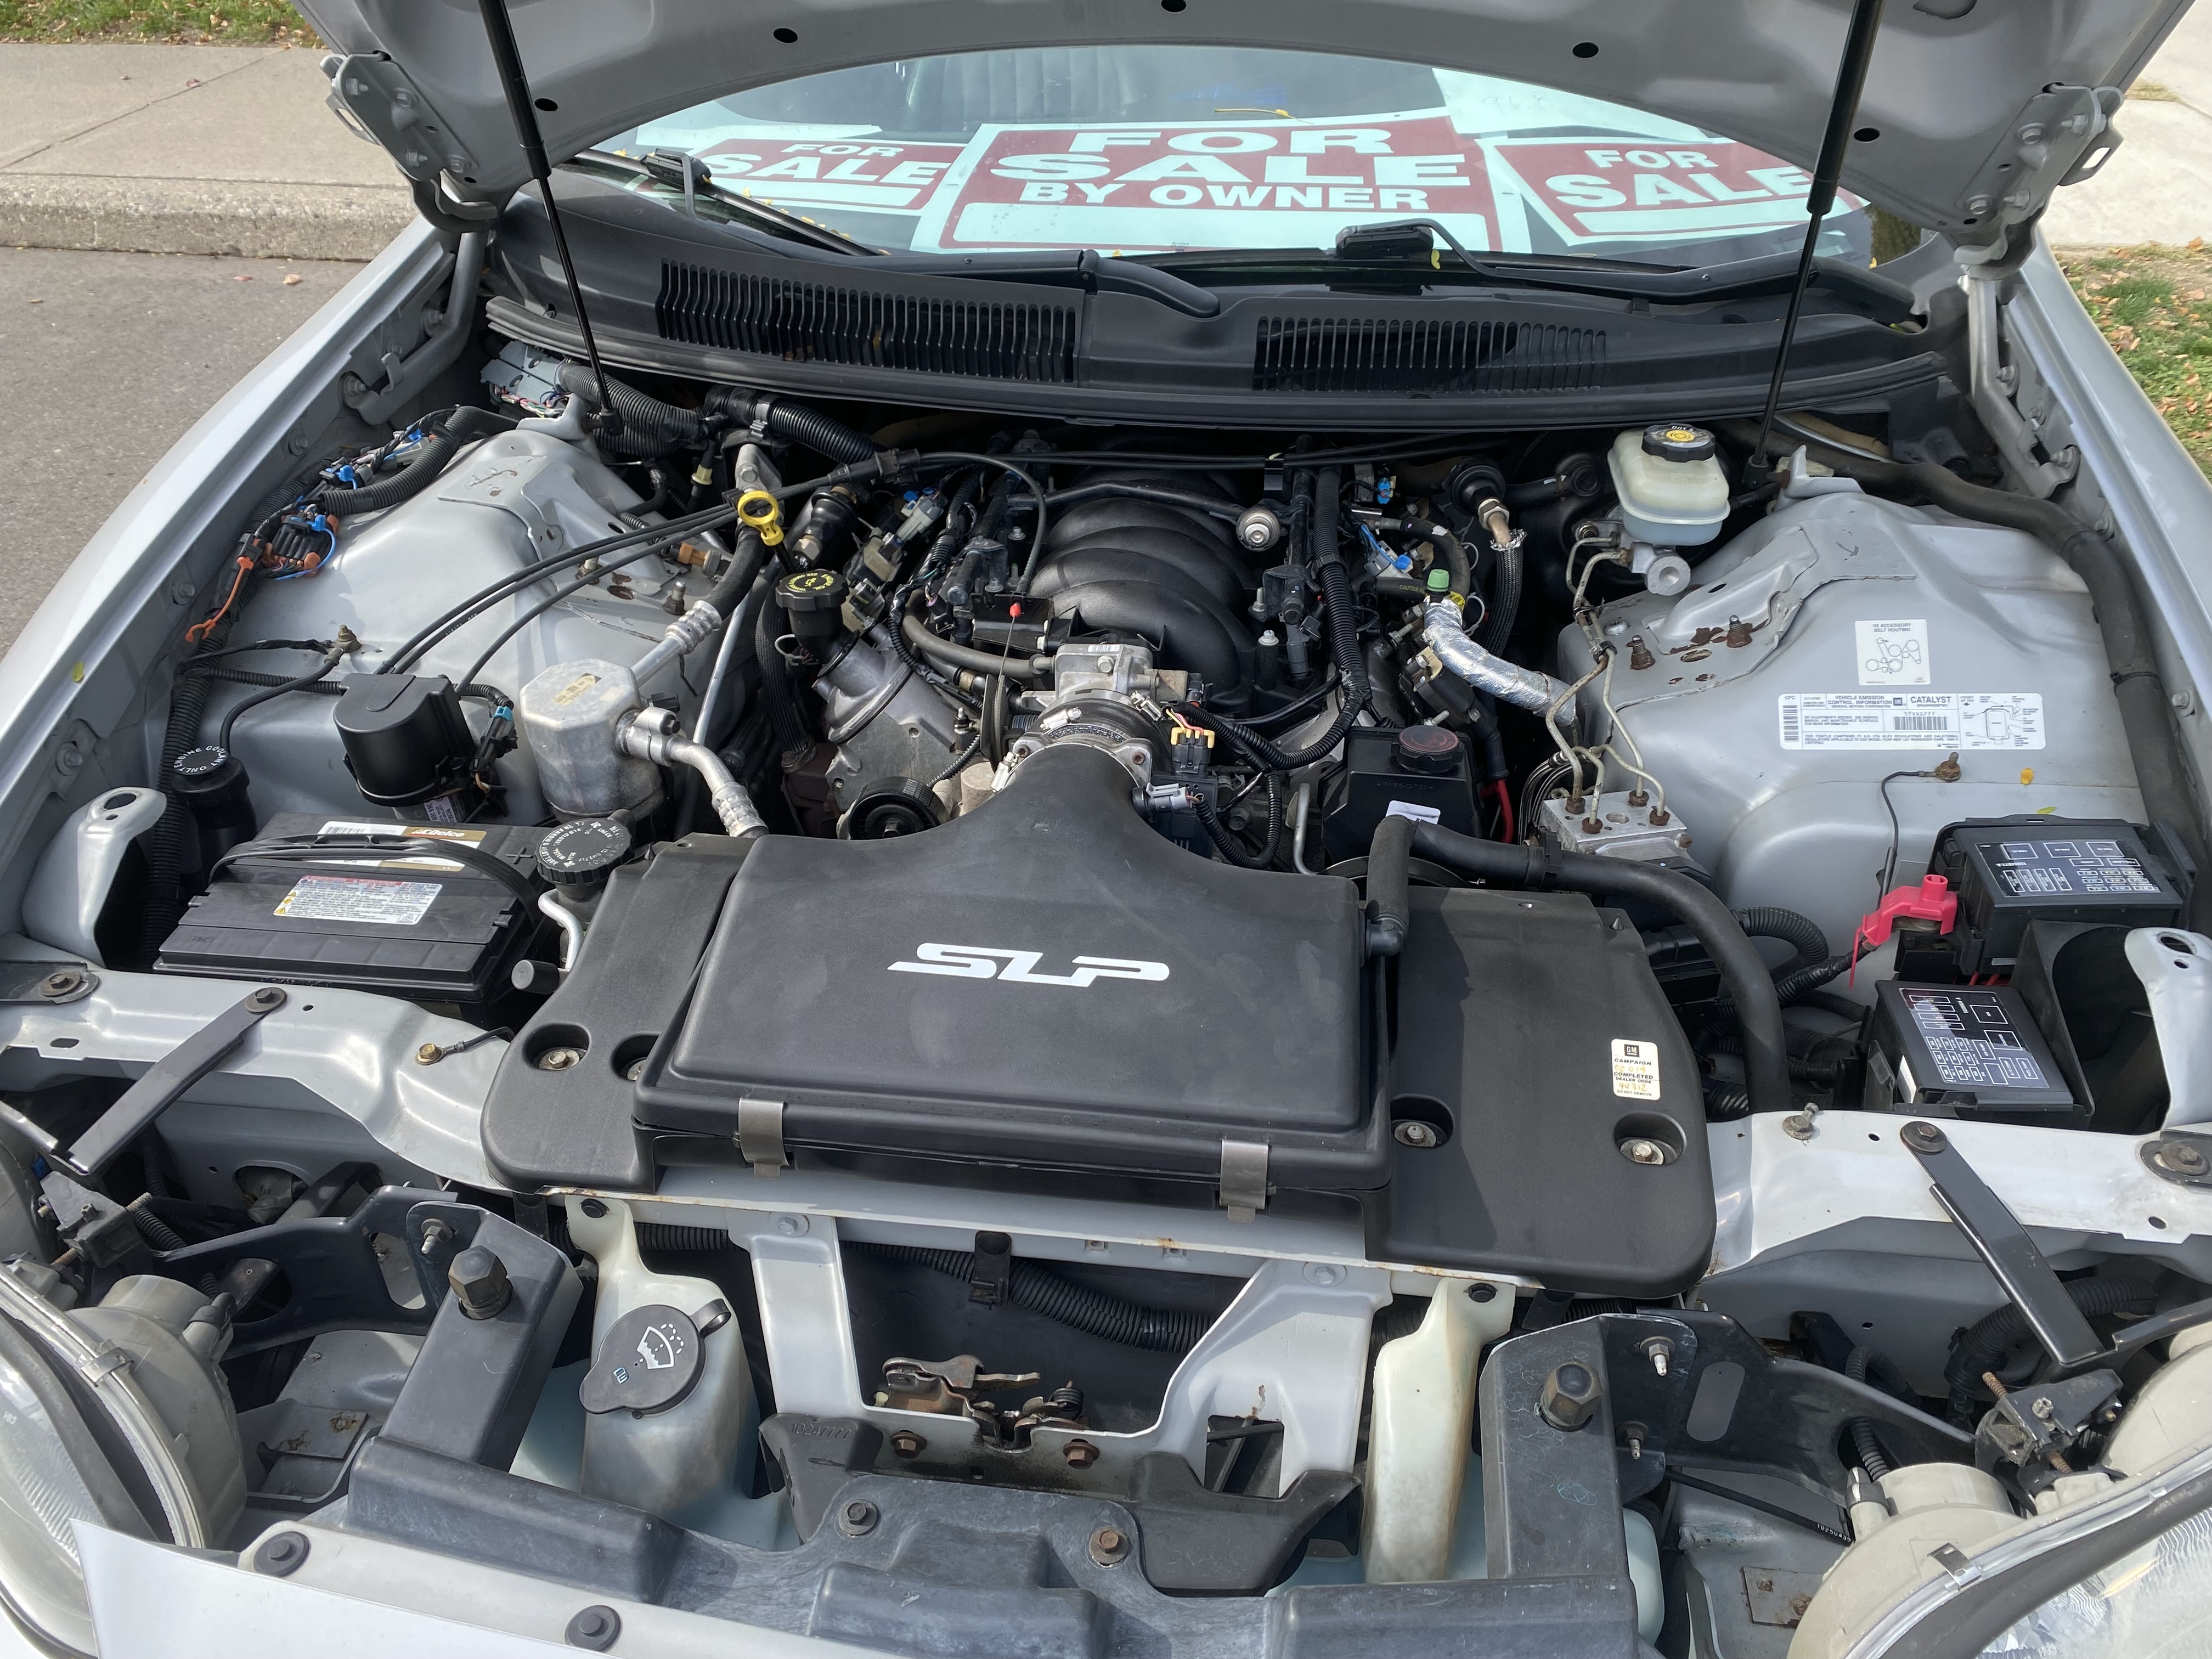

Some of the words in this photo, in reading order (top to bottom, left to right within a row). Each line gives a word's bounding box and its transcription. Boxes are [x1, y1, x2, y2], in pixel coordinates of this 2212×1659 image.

[780, 144, 904, 157] FOR
[1068, 129, 1393, 155] FOR
[701, 154, 952, 185] SALE
[990, 154, 1470, 186] SALE
[1584, 150, 1719, 168] FOR
[1019, 182, 1126, 204] BY
[1149, 184, 1429, 210] OWNER
[1545, 166, 1811, 207] SALE
[1400, 584, 1419, 592] CAUTION
[174, 748, 202, 768] ENGINE
[206, 746, 226, 766] COOLANT
[411, 828, 465, 837] ACDelco
[887, 943, 1170, 988] SLP
[792, 1423, 851, 1440] 10247777
